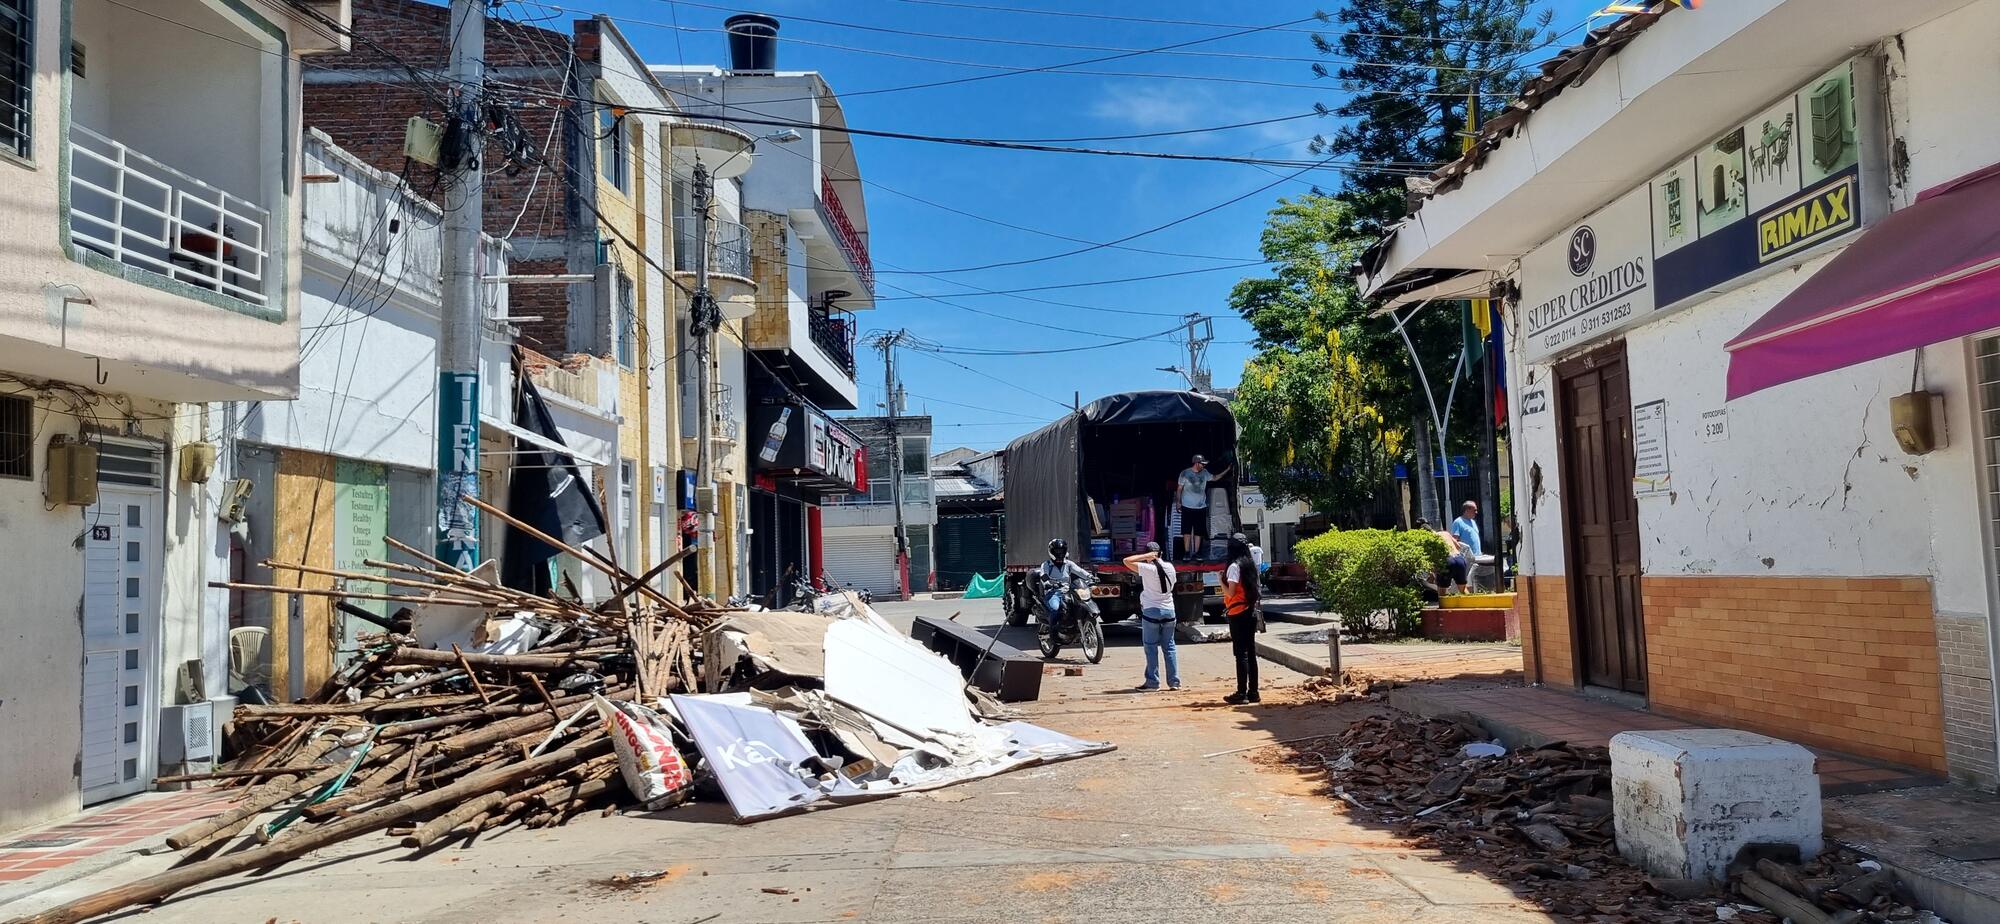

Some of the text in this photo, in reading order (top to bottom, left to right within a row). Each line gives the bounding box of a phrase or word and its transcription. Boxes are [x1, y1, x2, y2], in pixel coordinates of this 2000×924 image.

[1761, 186, 1849, 254] RIMAX
[1573, 231, 1590, 262] SC
[1528, 256, 1645, 332] SUPER CRÉDITOS
[1549, 302, 1632, 347] 222 0114 311 5312523
[1711, 422, 1724, 435] 200
[352, 512, 372, 525] Healthy
[353, 525, 371, 536] Omega
